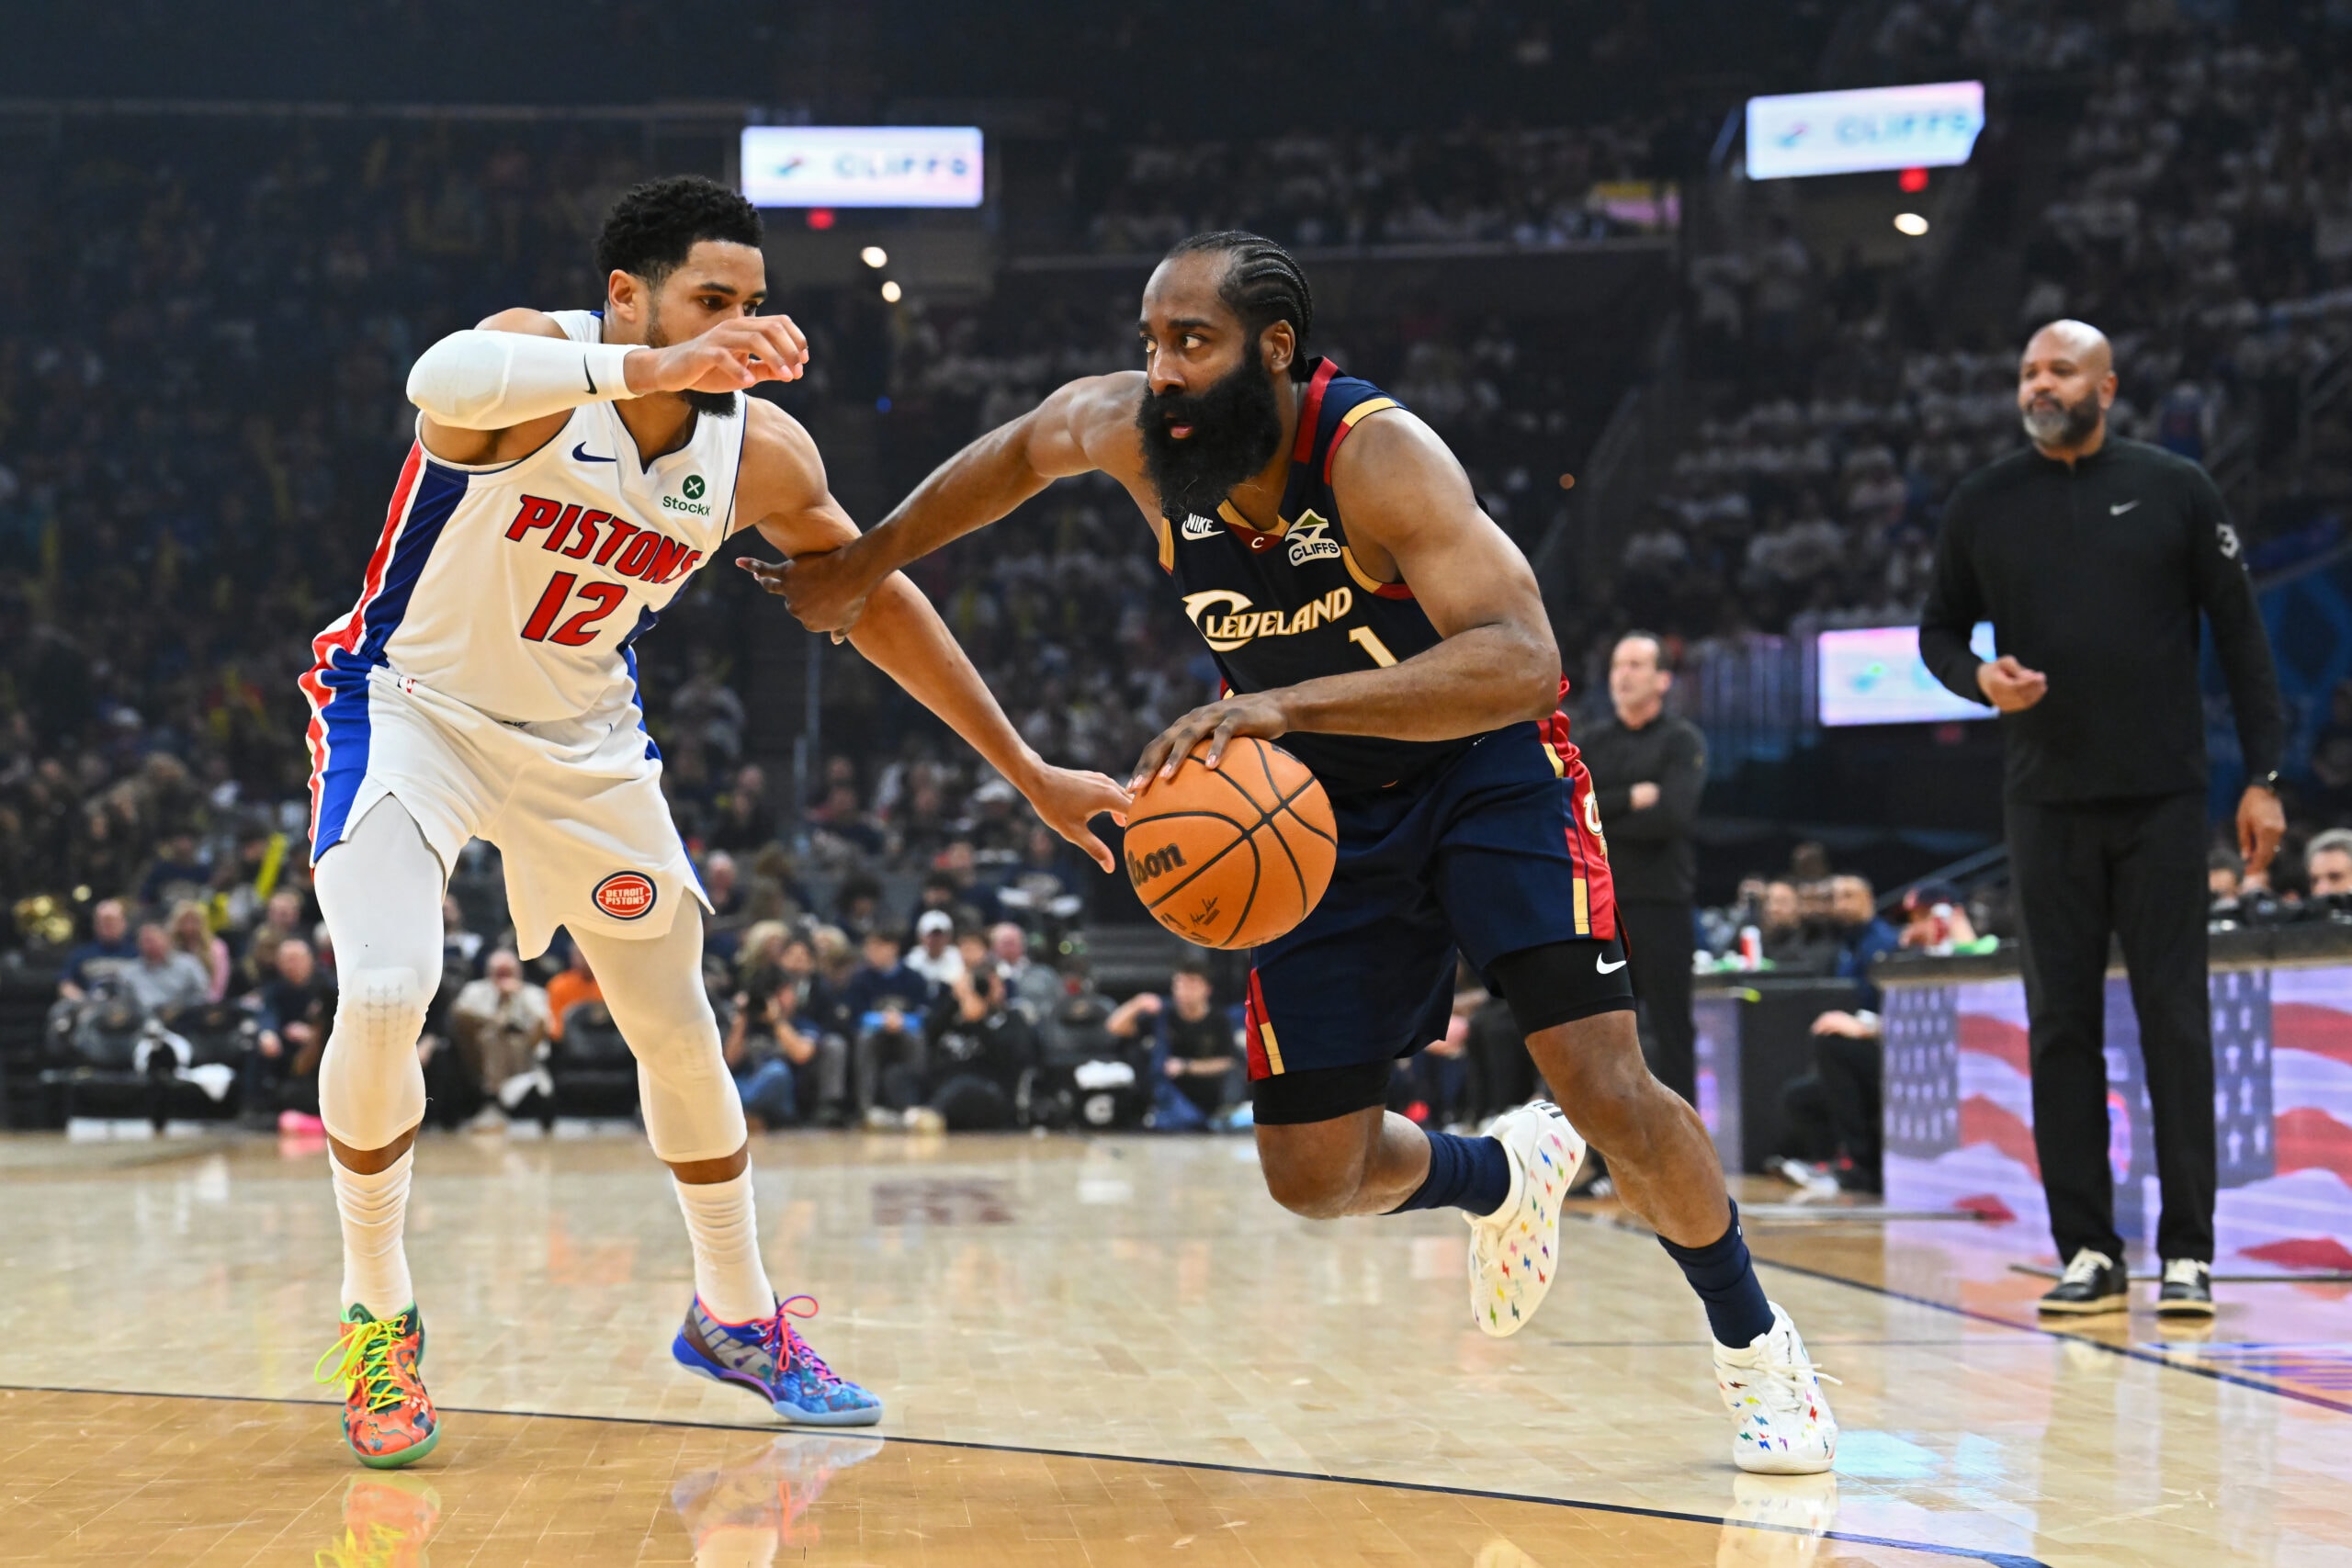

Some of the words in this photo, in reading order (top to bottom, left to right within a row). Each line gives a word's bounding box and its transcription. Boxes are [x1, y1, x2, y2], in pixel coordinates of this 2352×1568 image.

[504, 494, 703, 584] PISTONS
[1186, 513, 1214, 534] NIKE
[1291, 542, 1339, 562] CLIFFS
[520, 570, 628, 647] 12
[1182, 586, 1353, 652] CLEVELAND
[1349, 625, 1399, 669] 1
[1125, 842, 1187, 888] lson
[605, 887, 644, 897] DETROIT
[605, 896, 645, 906] PISTONS
